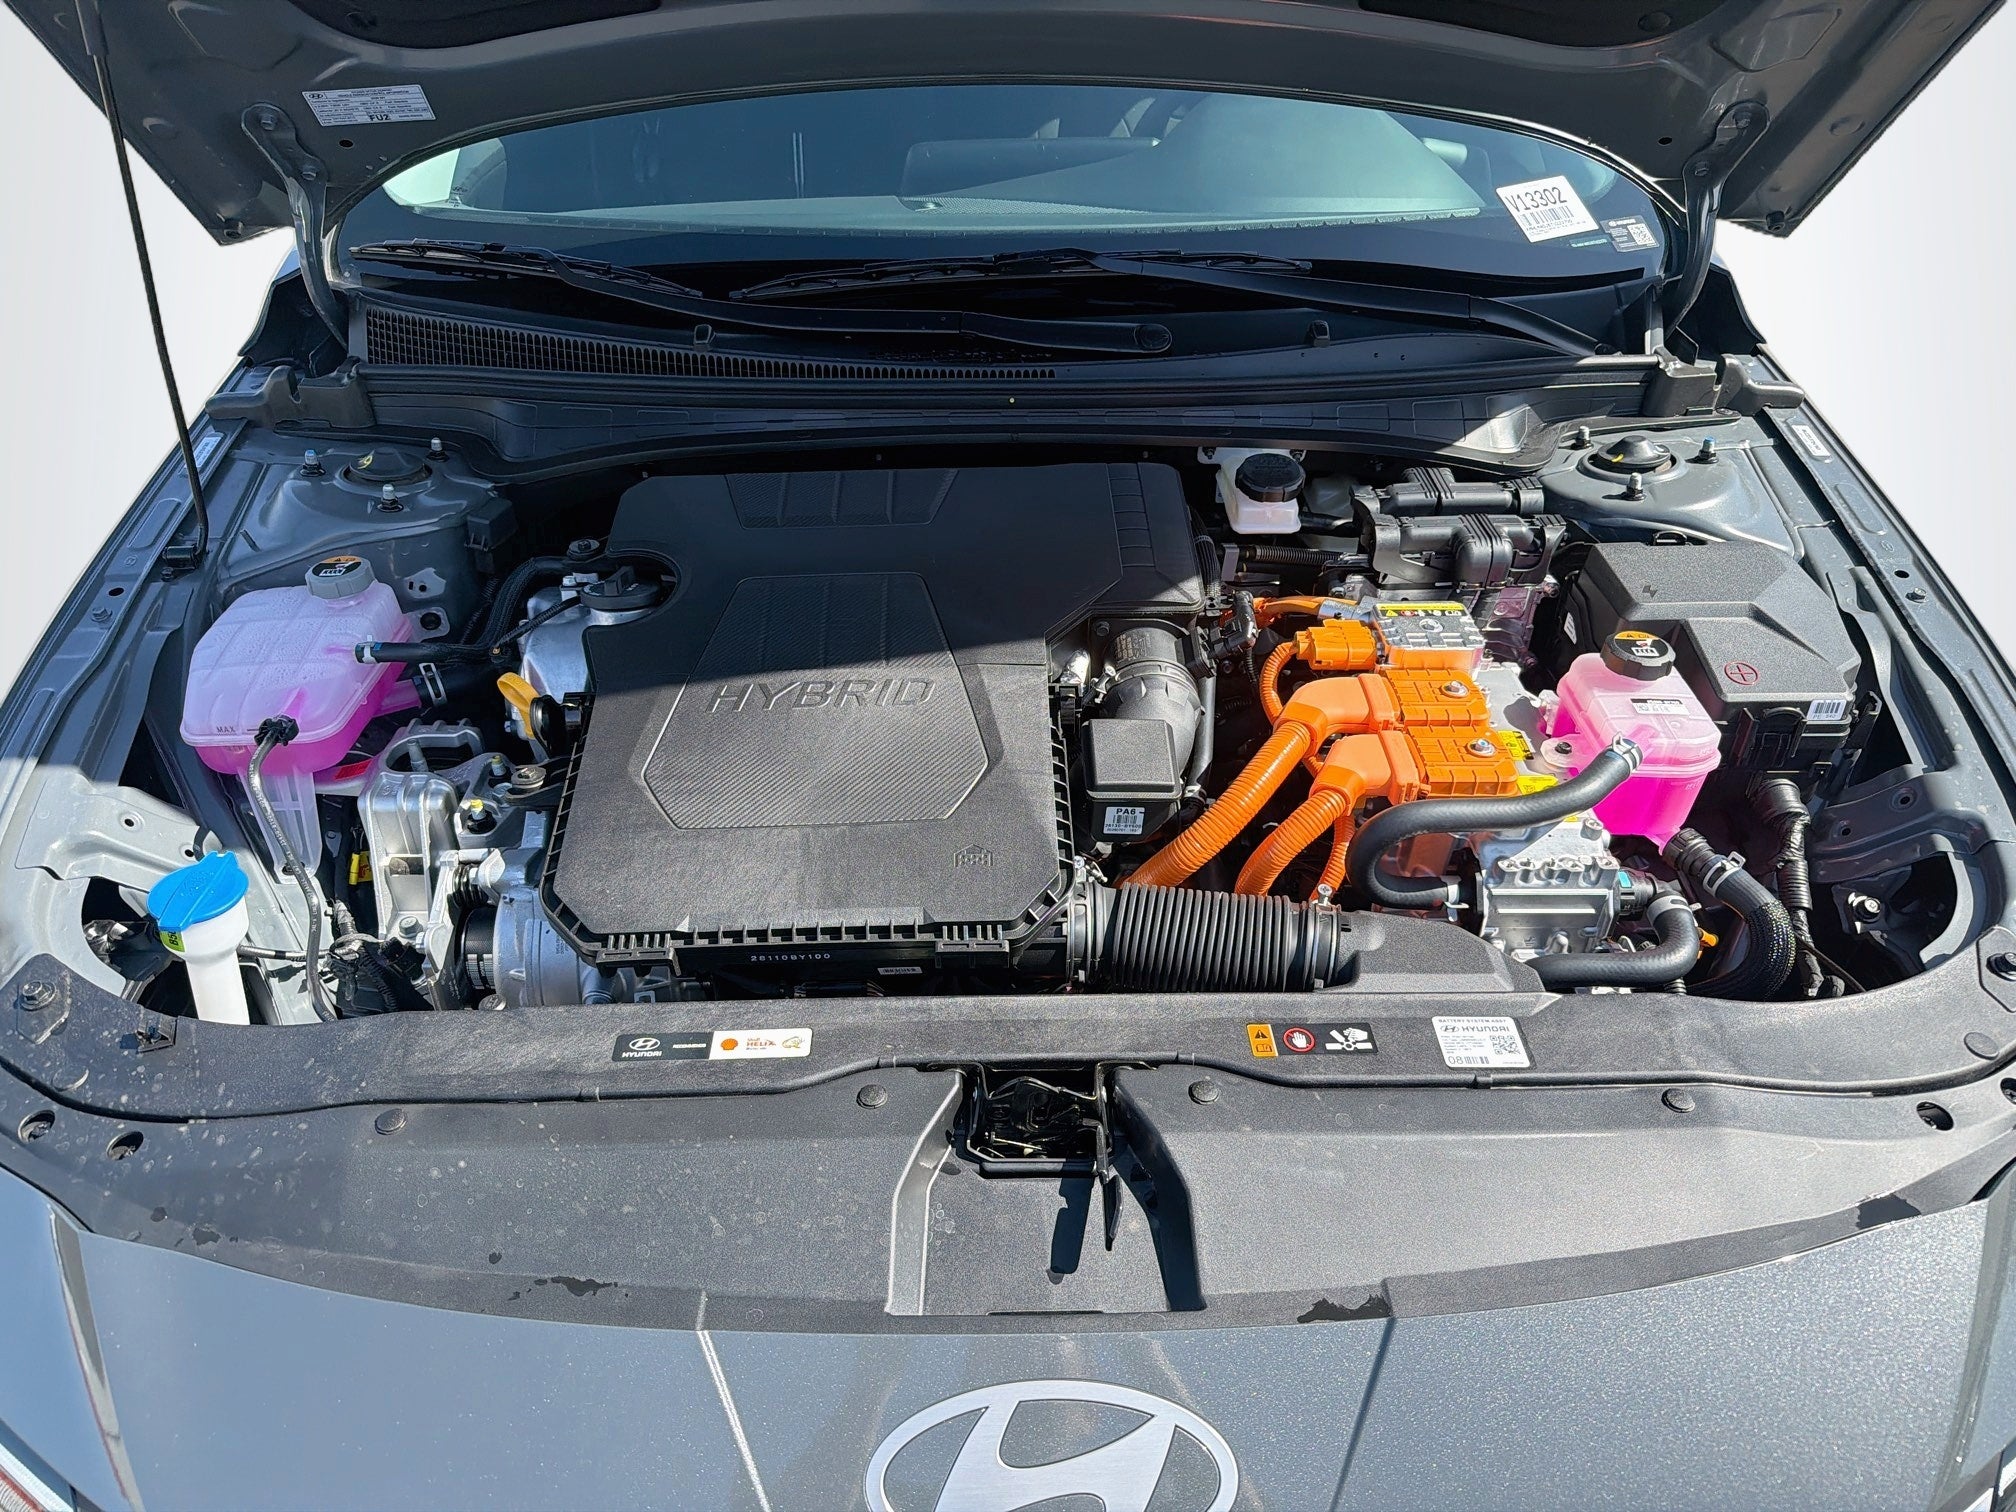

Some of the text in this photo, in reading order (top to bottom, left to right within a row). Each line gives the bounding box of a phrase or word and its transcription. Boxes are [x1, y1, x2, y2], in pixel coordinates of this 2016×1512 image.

[1505, 186, 1567, 212] V13302
[705, 679, 935, 712] HYBRID
[621, 1050, 663, 1058] HYUNDAI
